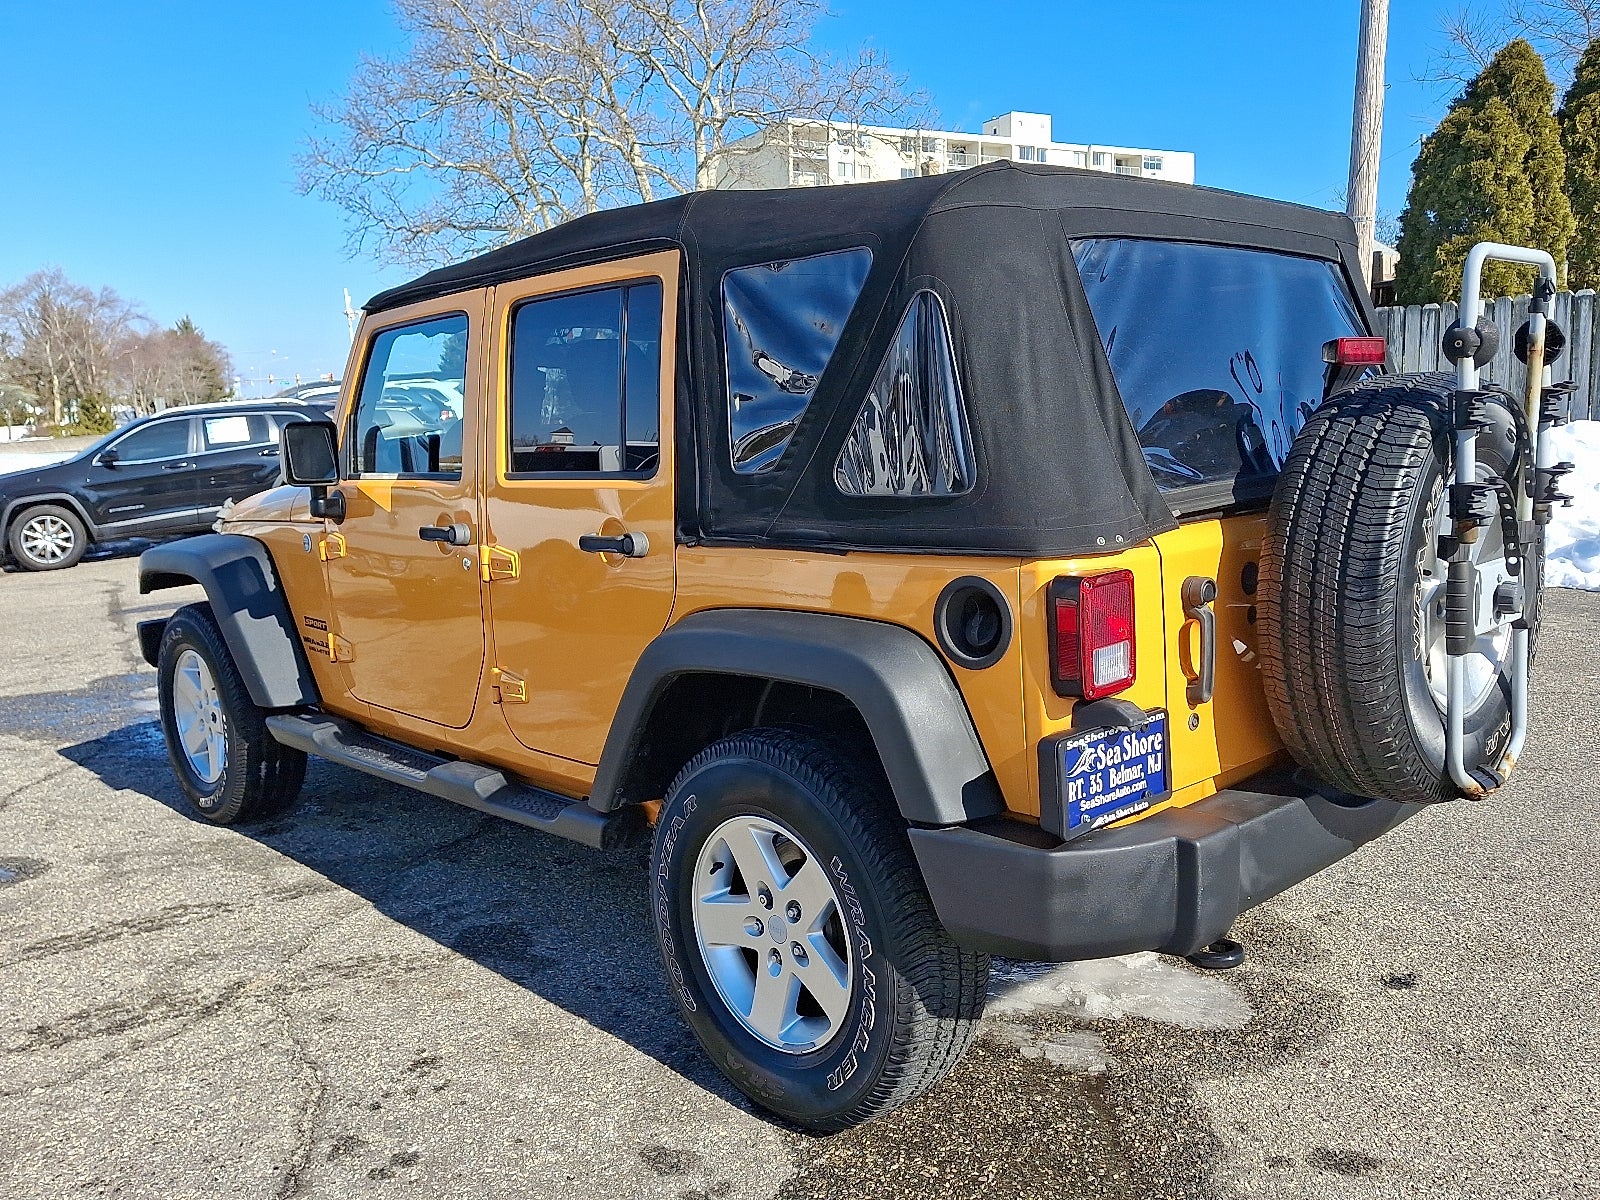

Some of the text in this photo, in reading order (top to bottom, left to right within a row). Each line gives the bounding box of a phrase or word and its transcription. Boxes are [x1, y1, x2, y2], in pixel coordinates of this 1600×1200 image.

[303, 635, 329, 649] WRANGLE
[305, 618, 327, 629] SPORT
[1096, 733, 1162, 770] Sea Shore
[1068, 752, 1162, 802] RT. 35 Belmar, NJ
[1080, 780, 1148, 811] SeaShoreAuto.com
[657, 794, 698, 1012] GOODYEAR
[826, 855, 877, 1091] WRANGLER
